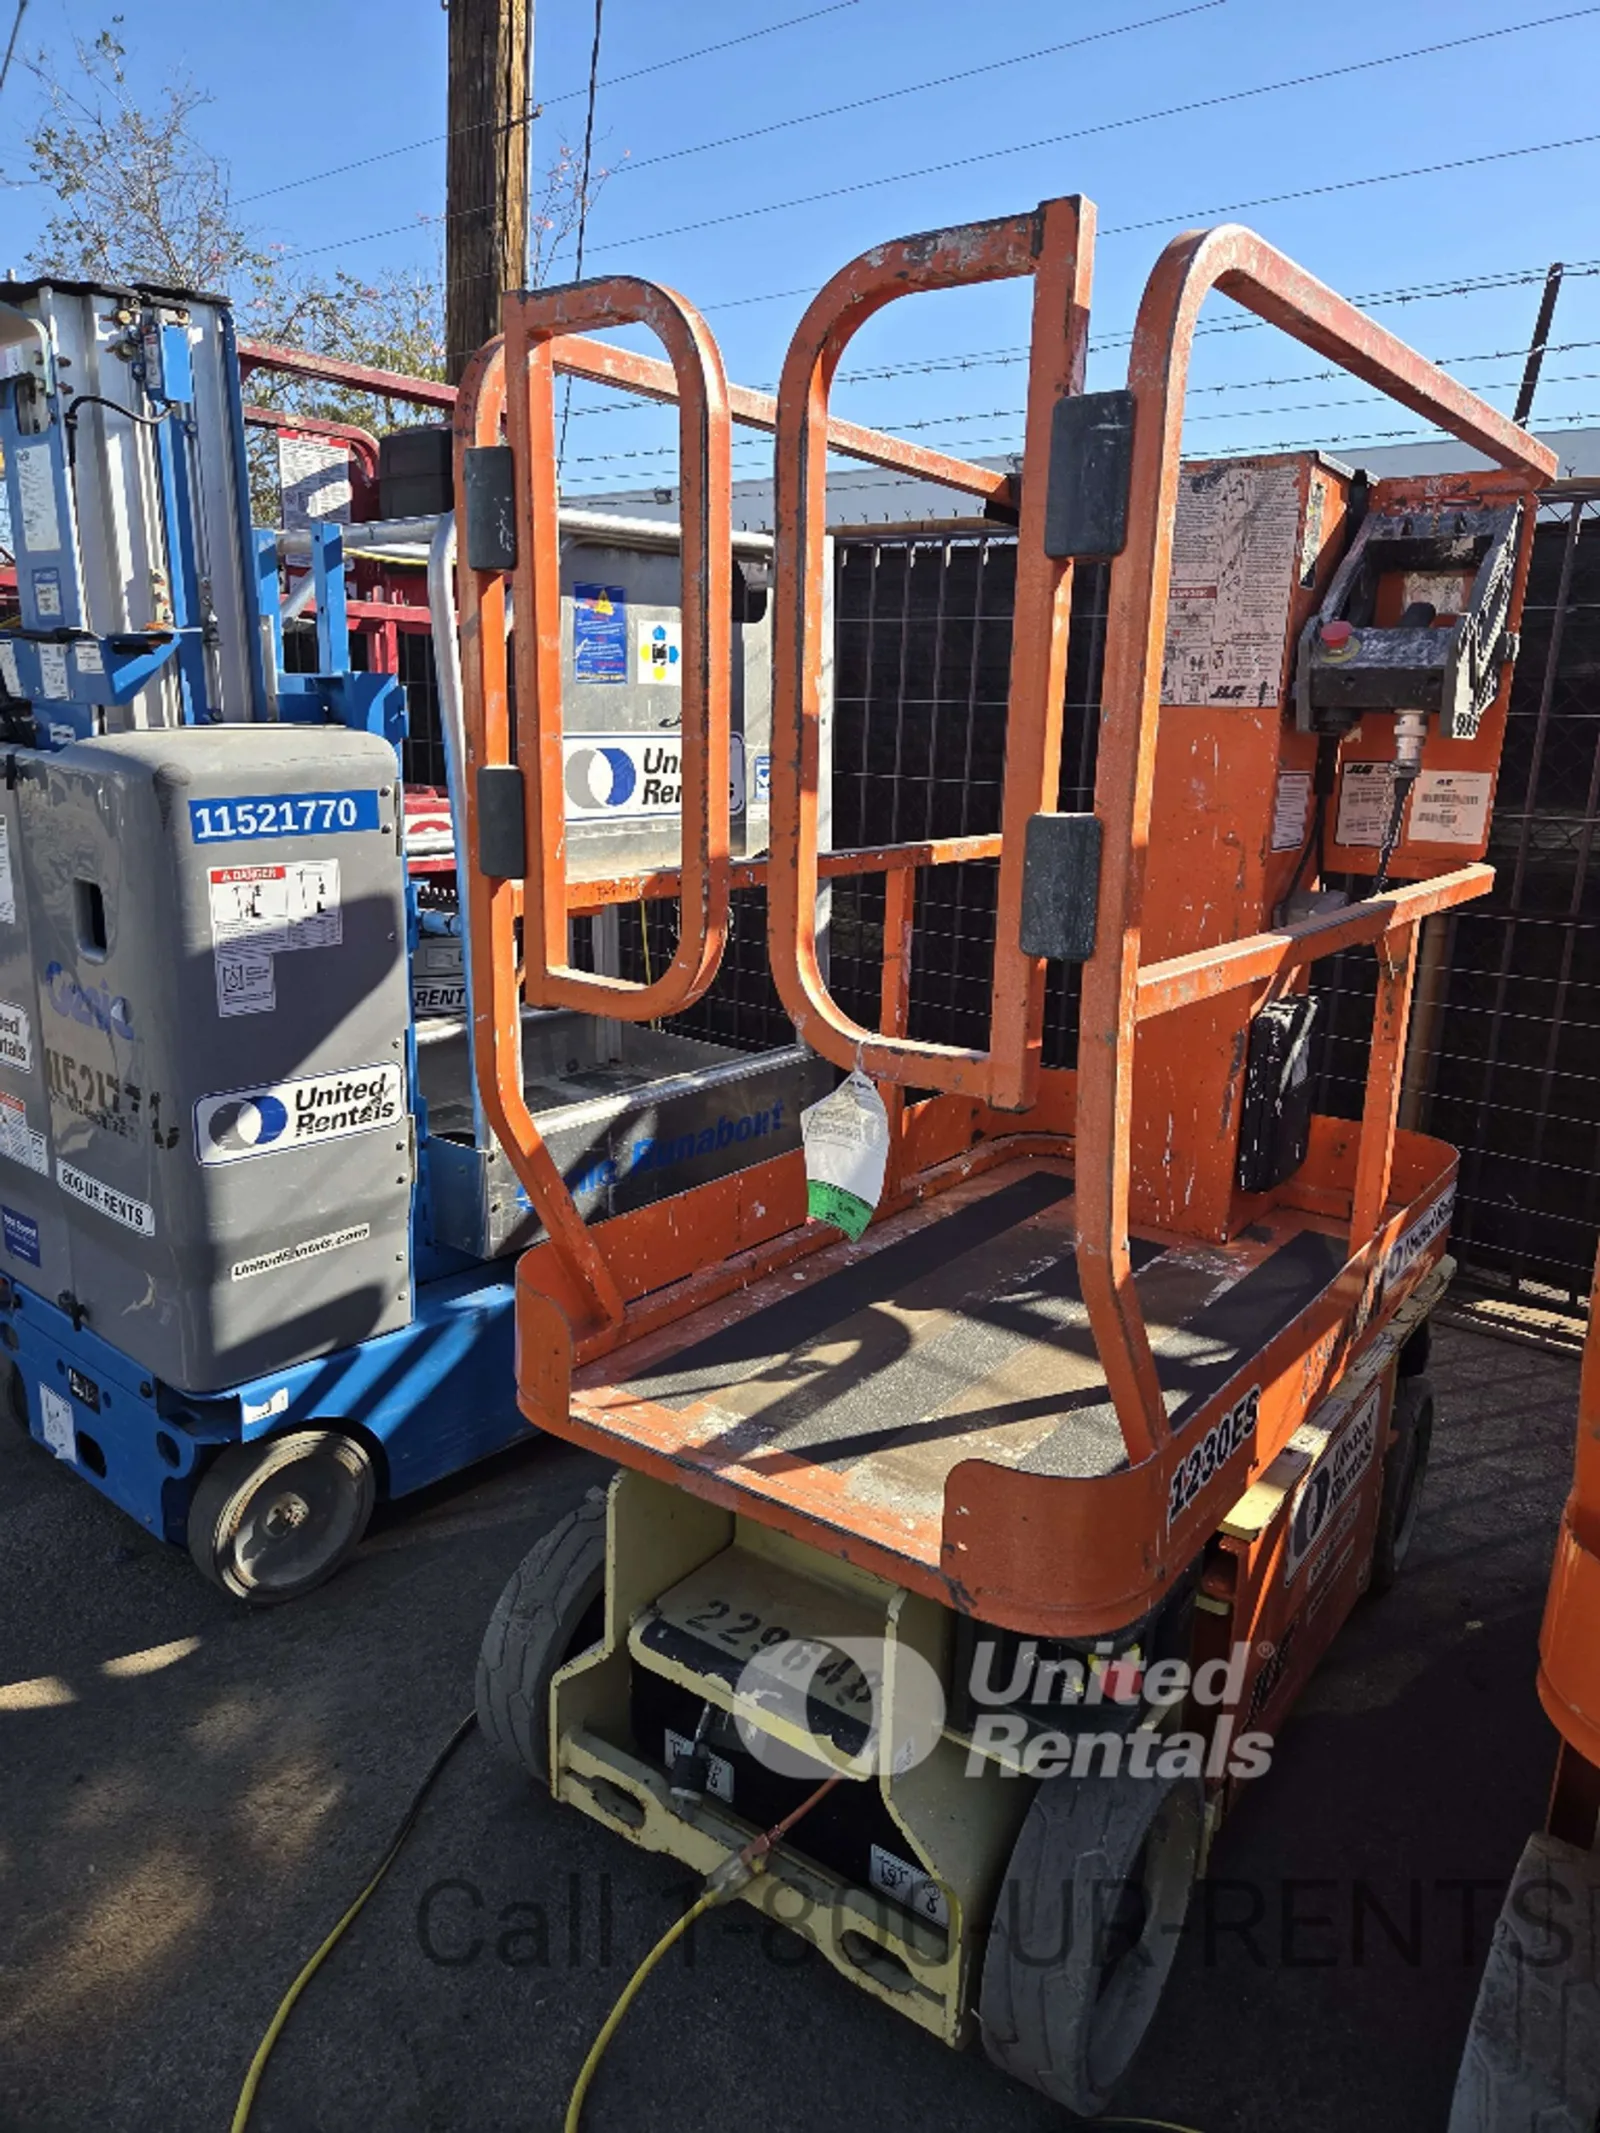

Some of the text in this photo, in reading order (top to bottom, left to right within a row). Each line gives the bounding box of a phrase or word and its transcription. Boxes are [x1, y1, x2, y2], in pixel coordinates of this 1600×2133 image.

[1346, 764, 1374, 775] JLG
[194, 797, 358, 839] 11521770
[294, 1072, 387, 1111] United
[294, 1099, 395, 1138] Rentals
[631, 1099, 784, 1177] Runabout
[1168, 1383, 1262, 1524] 1230ES
